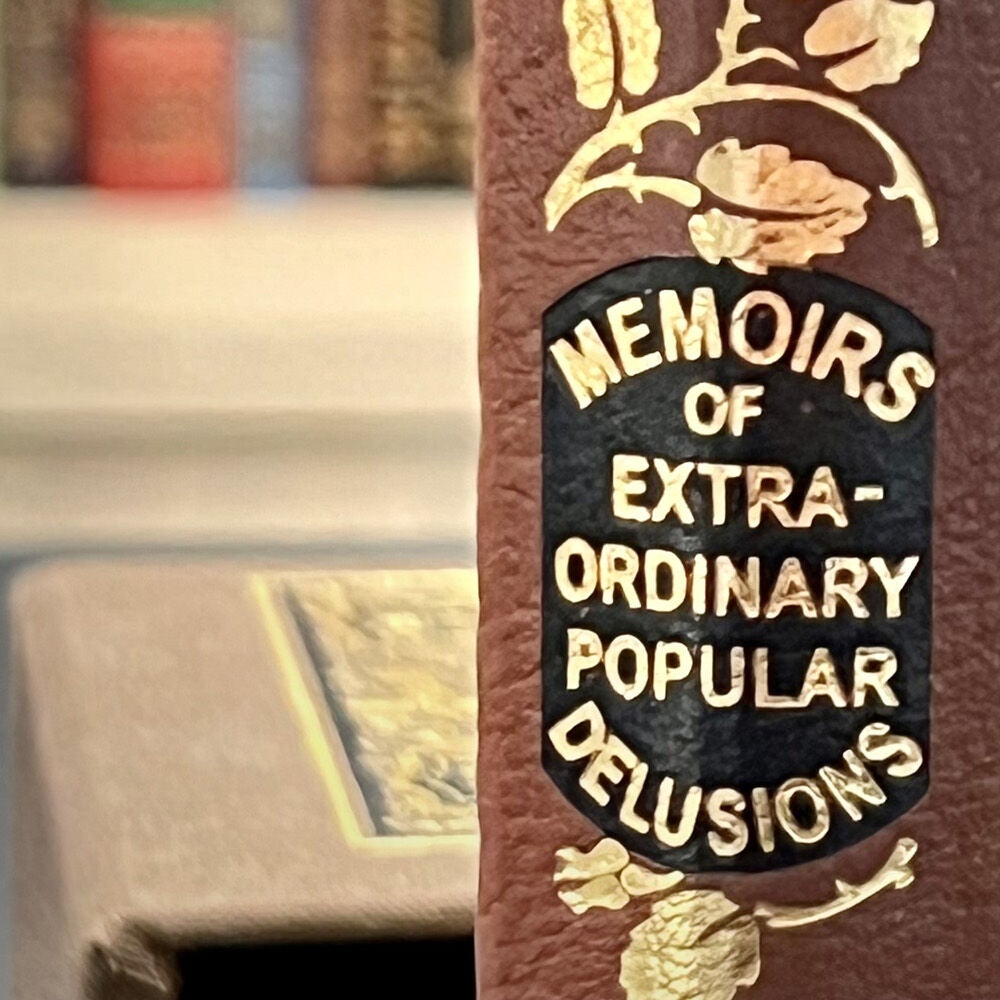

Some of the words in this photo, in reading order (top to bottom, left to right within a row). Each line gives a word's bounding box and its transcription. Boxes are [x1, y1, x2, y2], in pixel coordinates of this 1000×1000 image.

[550, 287, 936, 422] MEMOIRS
[684, 383, 765, 436] OF
[612, 454, 884, 528] EXTRA-
[554, 537, 919, 619] ORDINARY
[566, 628, 899, 708] POPULAR
[548, 700, 923, 856] DELUSIONS
